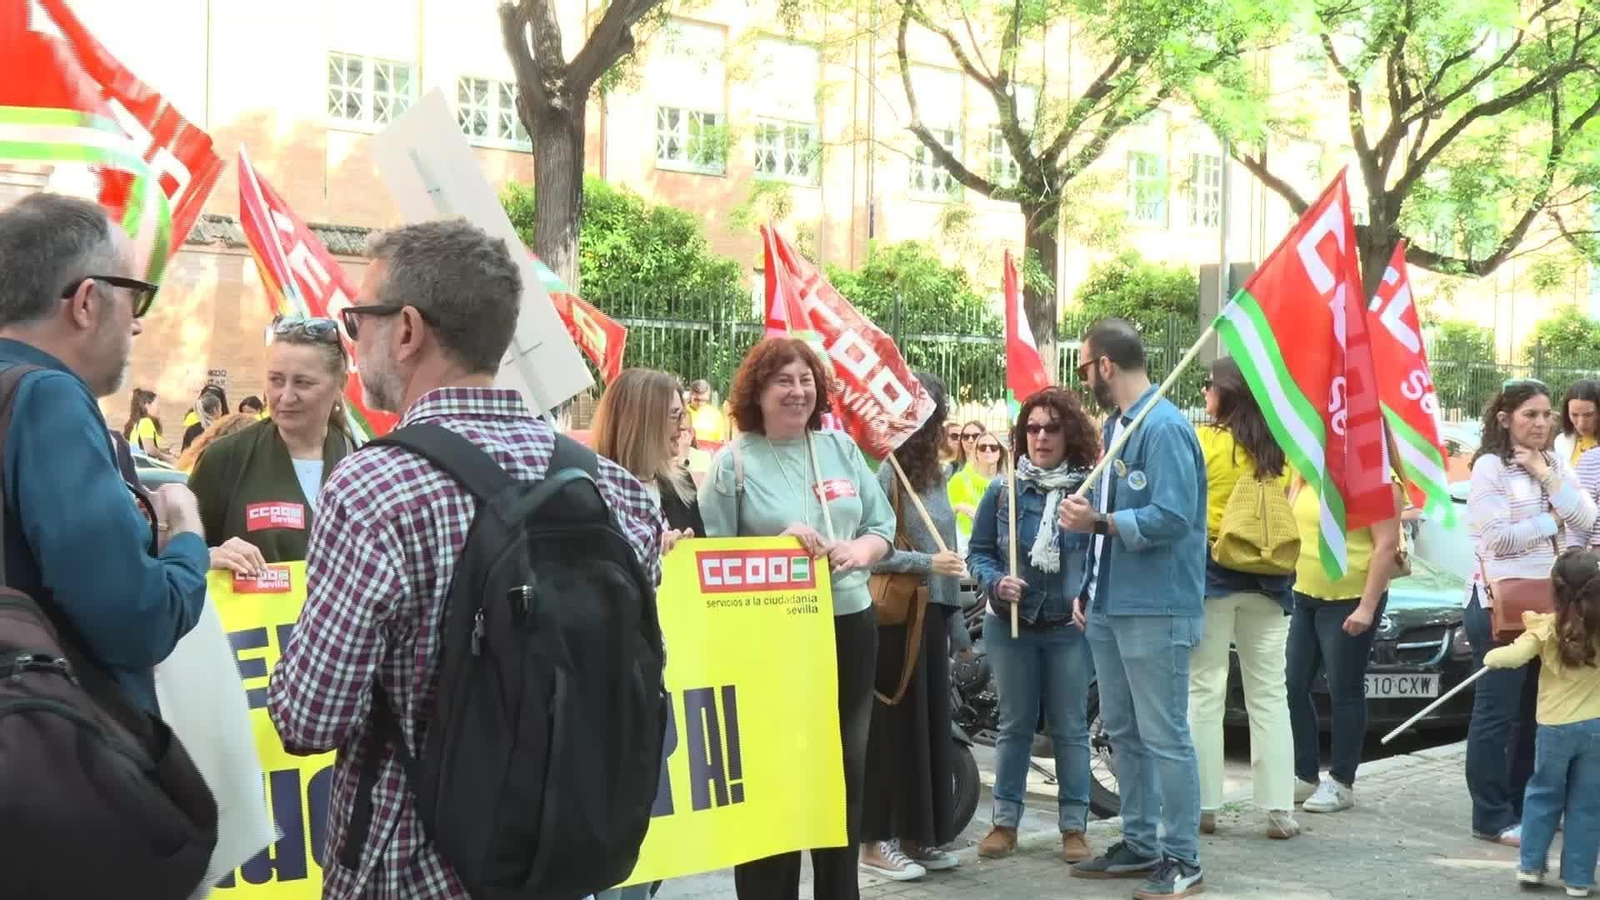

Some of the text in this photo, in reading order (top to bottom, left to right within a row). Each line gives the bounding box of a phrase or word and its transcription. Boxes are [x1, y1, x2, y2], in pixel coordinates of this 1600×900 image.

[701, 556, 788, 585] CCOO
[257, 579, 290, 588] Sevilla
[706, 599, 743, 608] servicios
[745, 598, 751, 606] a
[753, 595, 761, 606] la
[786, 604, 819, 615] sevilla
[1398, 677, 1431, 694] CXW
